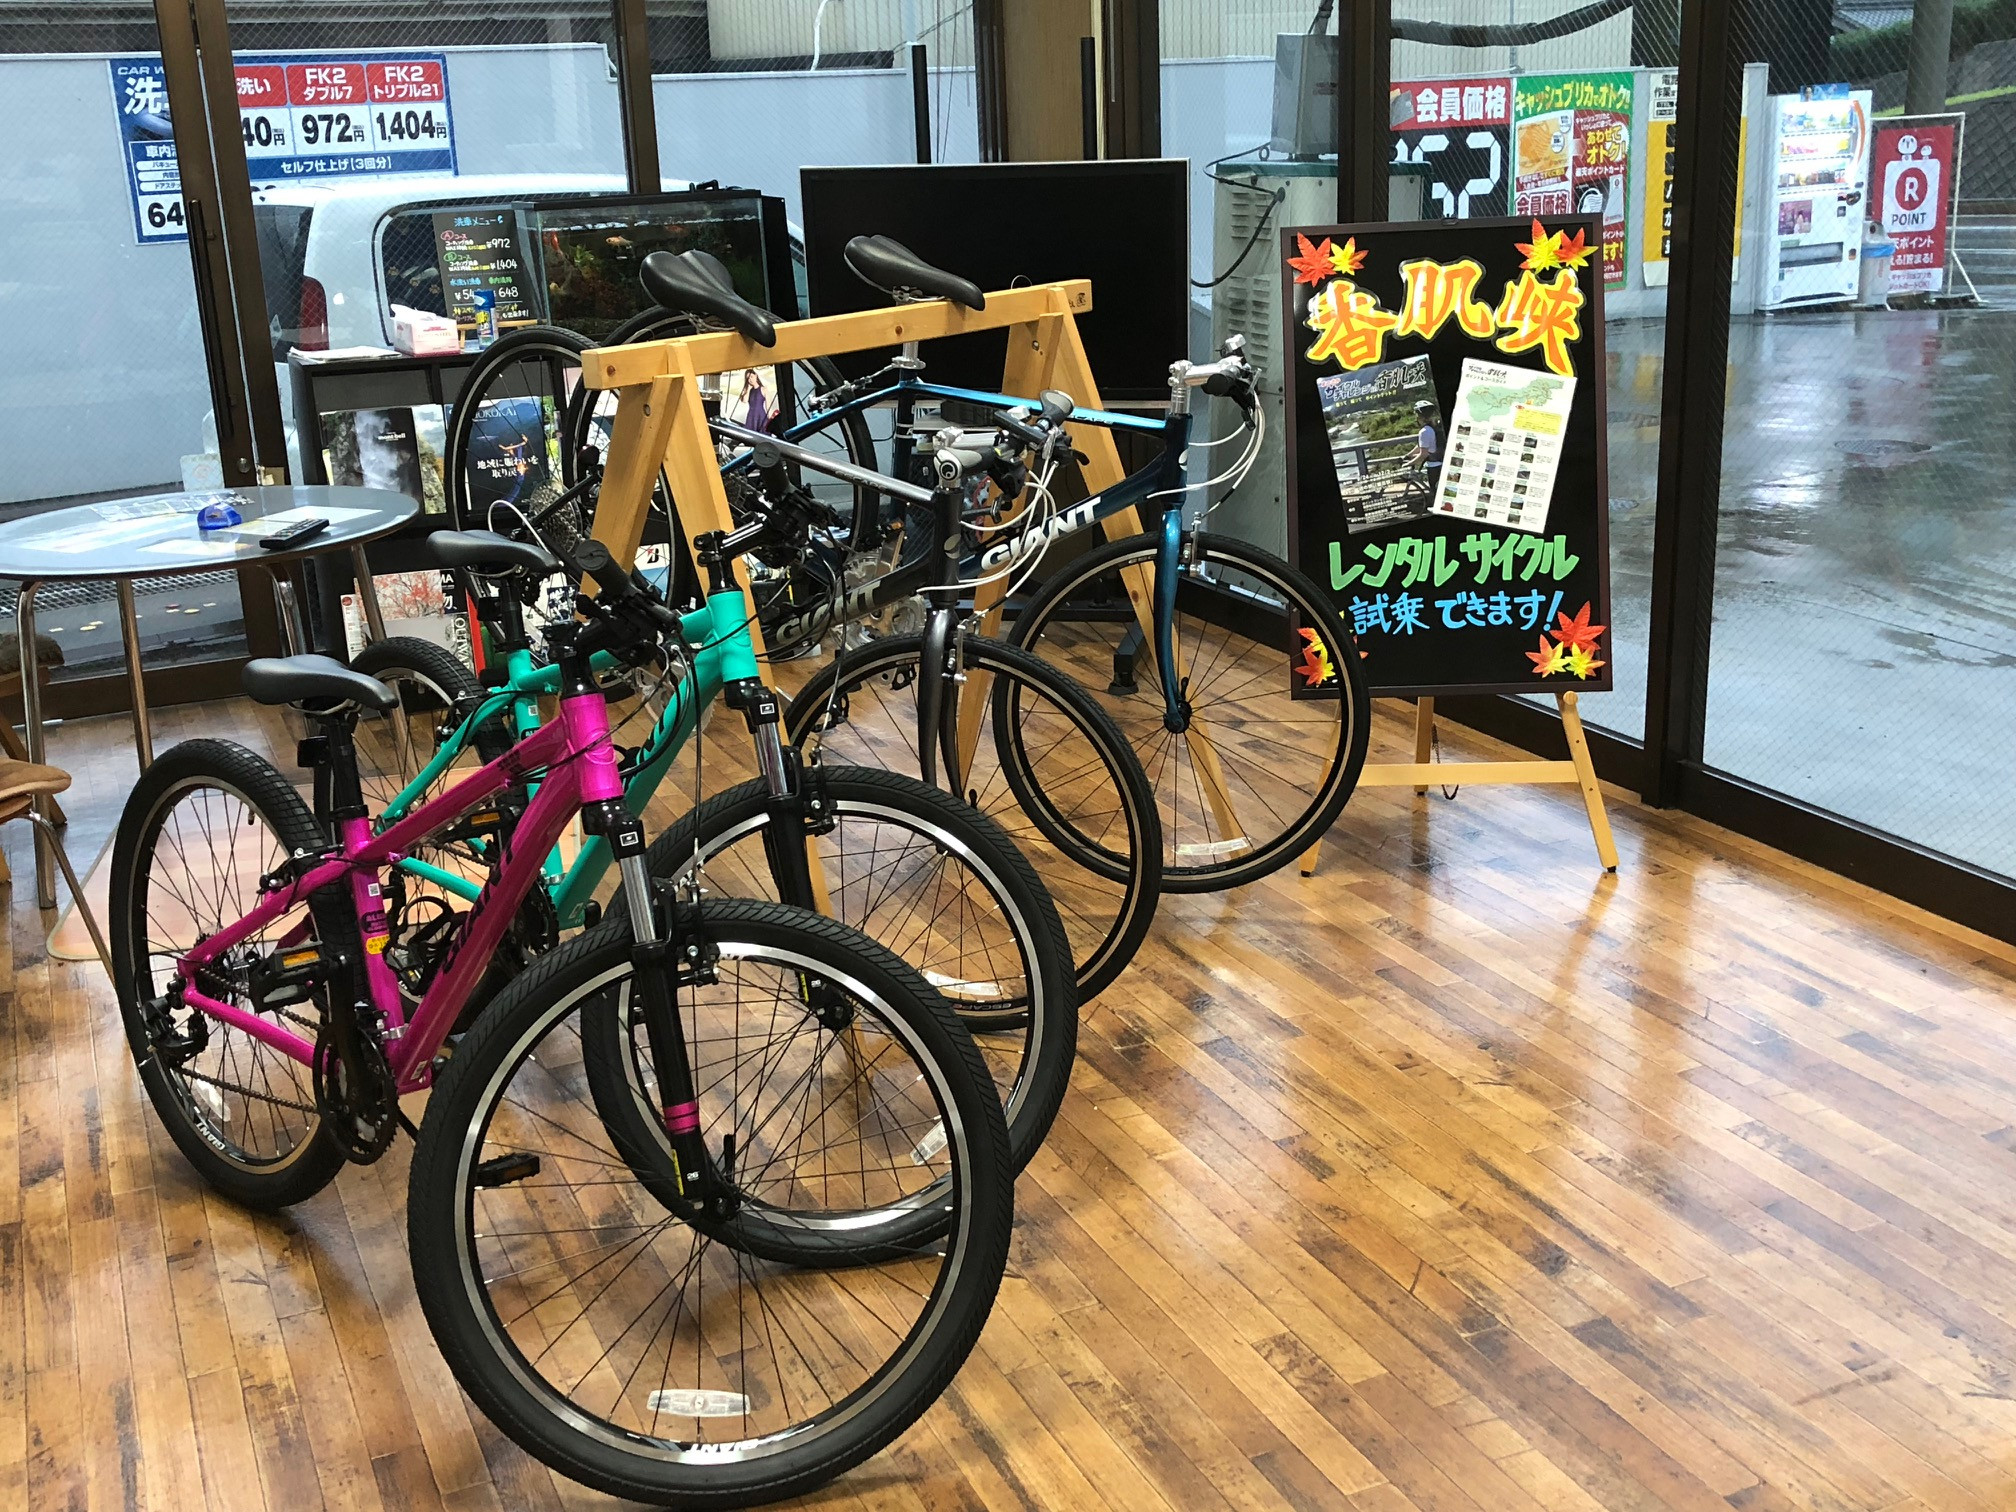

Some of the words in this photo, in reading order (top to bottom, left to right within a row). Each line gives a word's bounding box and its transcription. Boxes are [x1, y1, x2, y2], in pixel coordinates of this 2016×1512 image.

[117, 66, 150, 75] CAR
[305, 67, 347, 85] FK2
[384, 65, 424, 83] FK2
[124, 76, 169, 115] 洗
[303, 86, 353, 101] ダブル7
[1416, 86, 1506, 122] 会員価格
[1586, 125, 1622, 145] あわせて
[1891, 212, 1927, 226] POINT
[981, 495, 1102, 571] GIANT
[195, 1122, 226, 1151] GIANT
